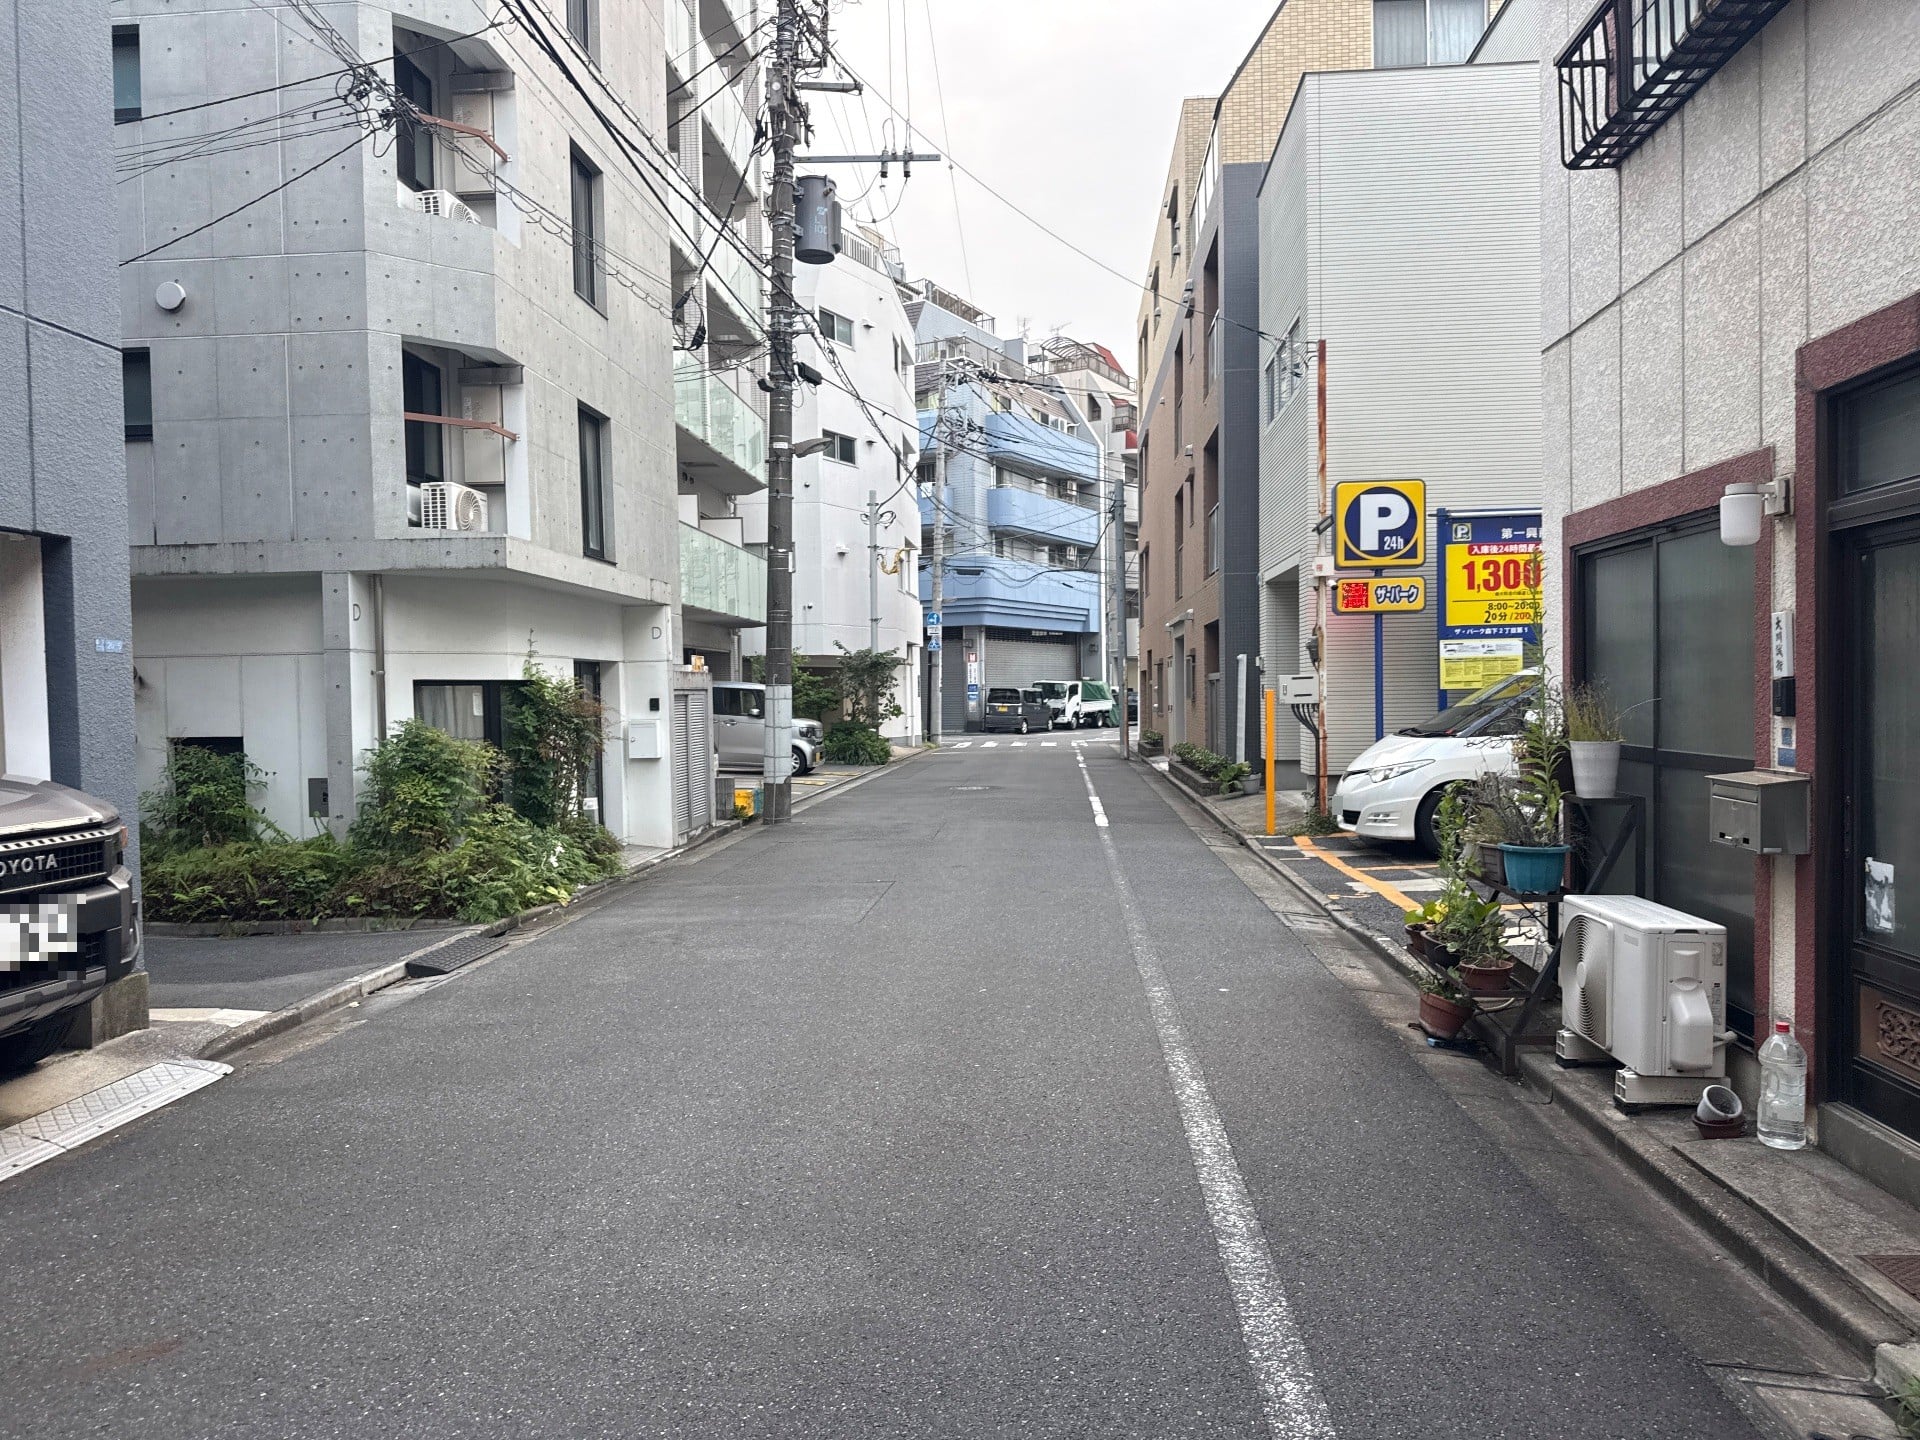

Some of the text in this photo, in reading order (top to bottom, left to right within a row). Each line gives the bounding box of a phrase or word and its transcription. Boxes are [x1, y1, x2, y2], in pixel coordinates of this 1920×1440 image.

[1360, 493, 1410, 551] P
[1383, 535, 1405, 551] 24h
[651, 626, 662, 640] D
